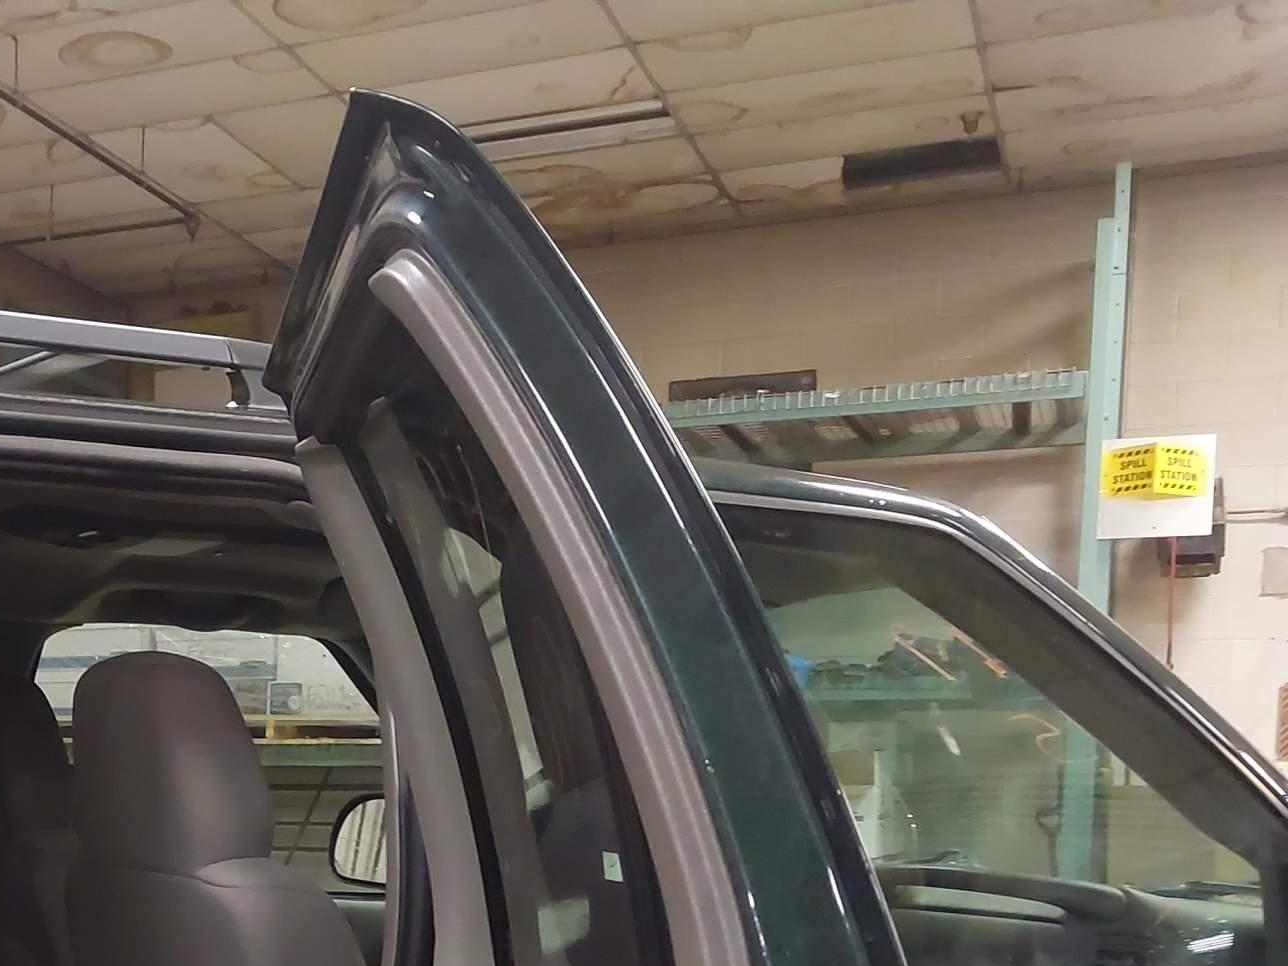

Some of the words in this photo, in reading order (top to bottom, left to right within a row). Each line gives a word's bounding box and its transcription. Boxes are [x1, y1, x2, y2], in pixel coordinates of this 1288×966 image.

[1120, 458, 1147, 470] SPILL
[1168, 457, 1192, 468] SPILL
[1113, 471, 1153, 485] STATION
[1160, 471, 1197, 482] STATION
